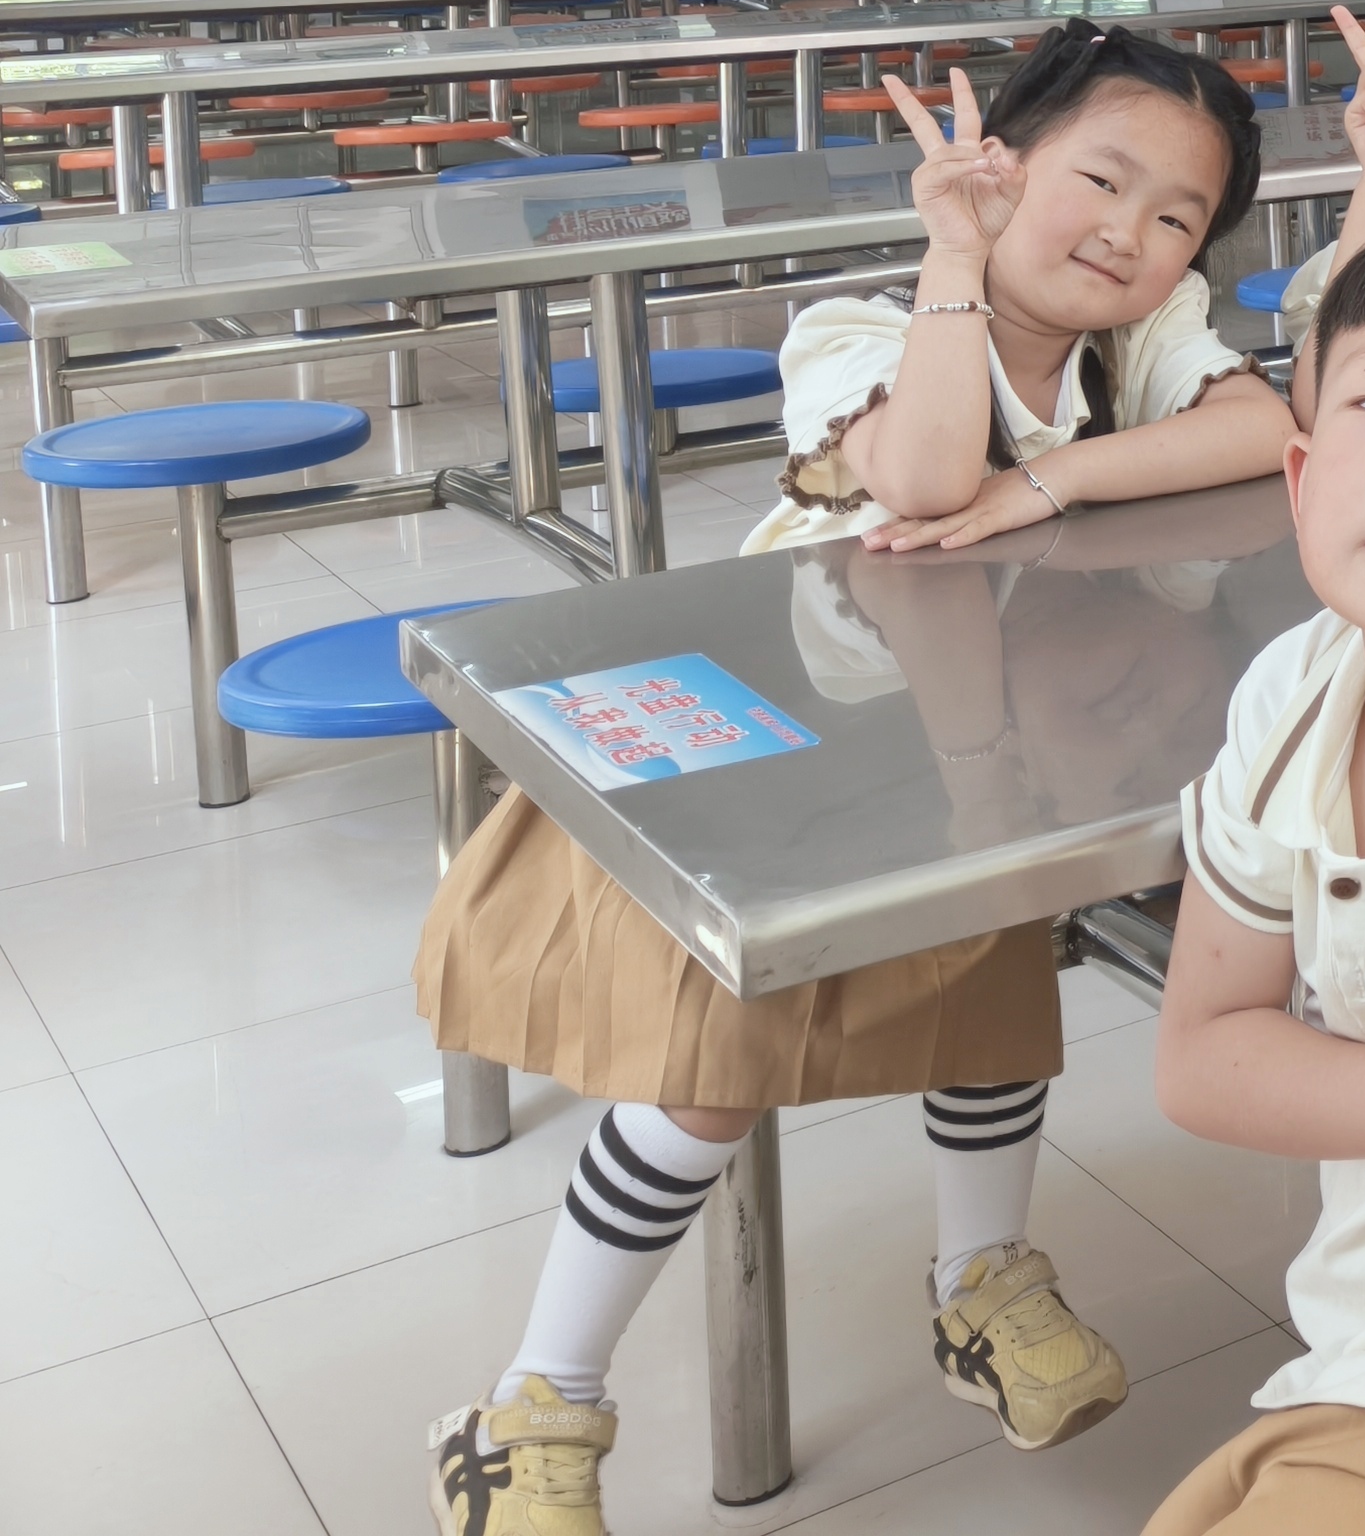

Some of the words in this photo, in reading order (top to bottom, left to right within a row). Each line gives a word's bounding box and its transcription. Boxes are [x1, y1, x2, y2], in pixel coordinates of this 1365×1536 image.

[548, 690, 675, 767] 从我做起
[616, 677, 751, 751] 光盘行动
[529, 1413, 602, 1427] BOBDOG
